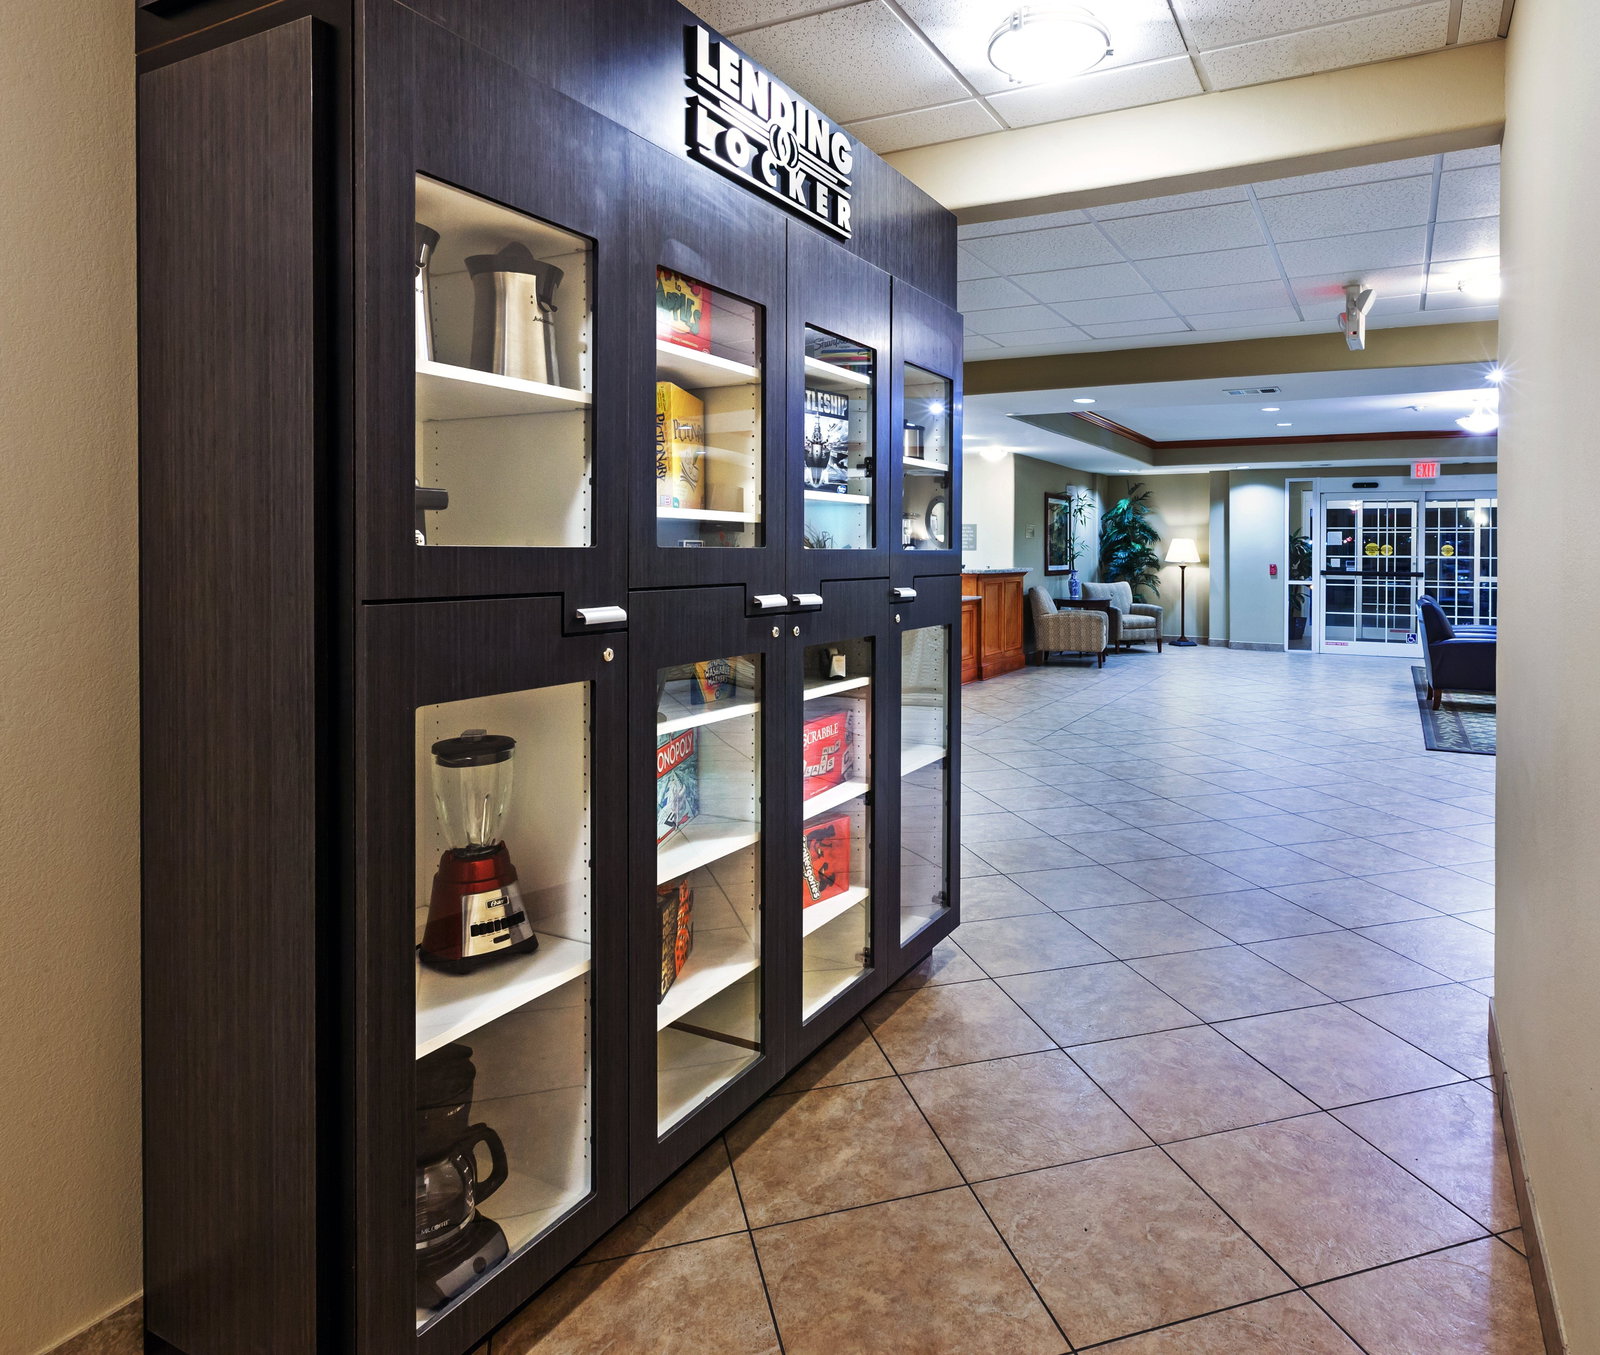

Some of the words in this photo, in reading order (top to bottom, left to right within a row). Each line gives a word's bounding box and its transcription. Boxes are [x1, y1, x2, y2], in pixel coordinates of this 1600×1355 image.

[696, 24, 853, 175] LENDING
[696, 104, 852, 232] LOCKER
[656, 279, 702, 336] APPLES
[1415, 463, 1436, 478] EXIT
[657, 733, 692, 773] ONOPOLY
[803, 722, 839, 747] SCRABBLE
